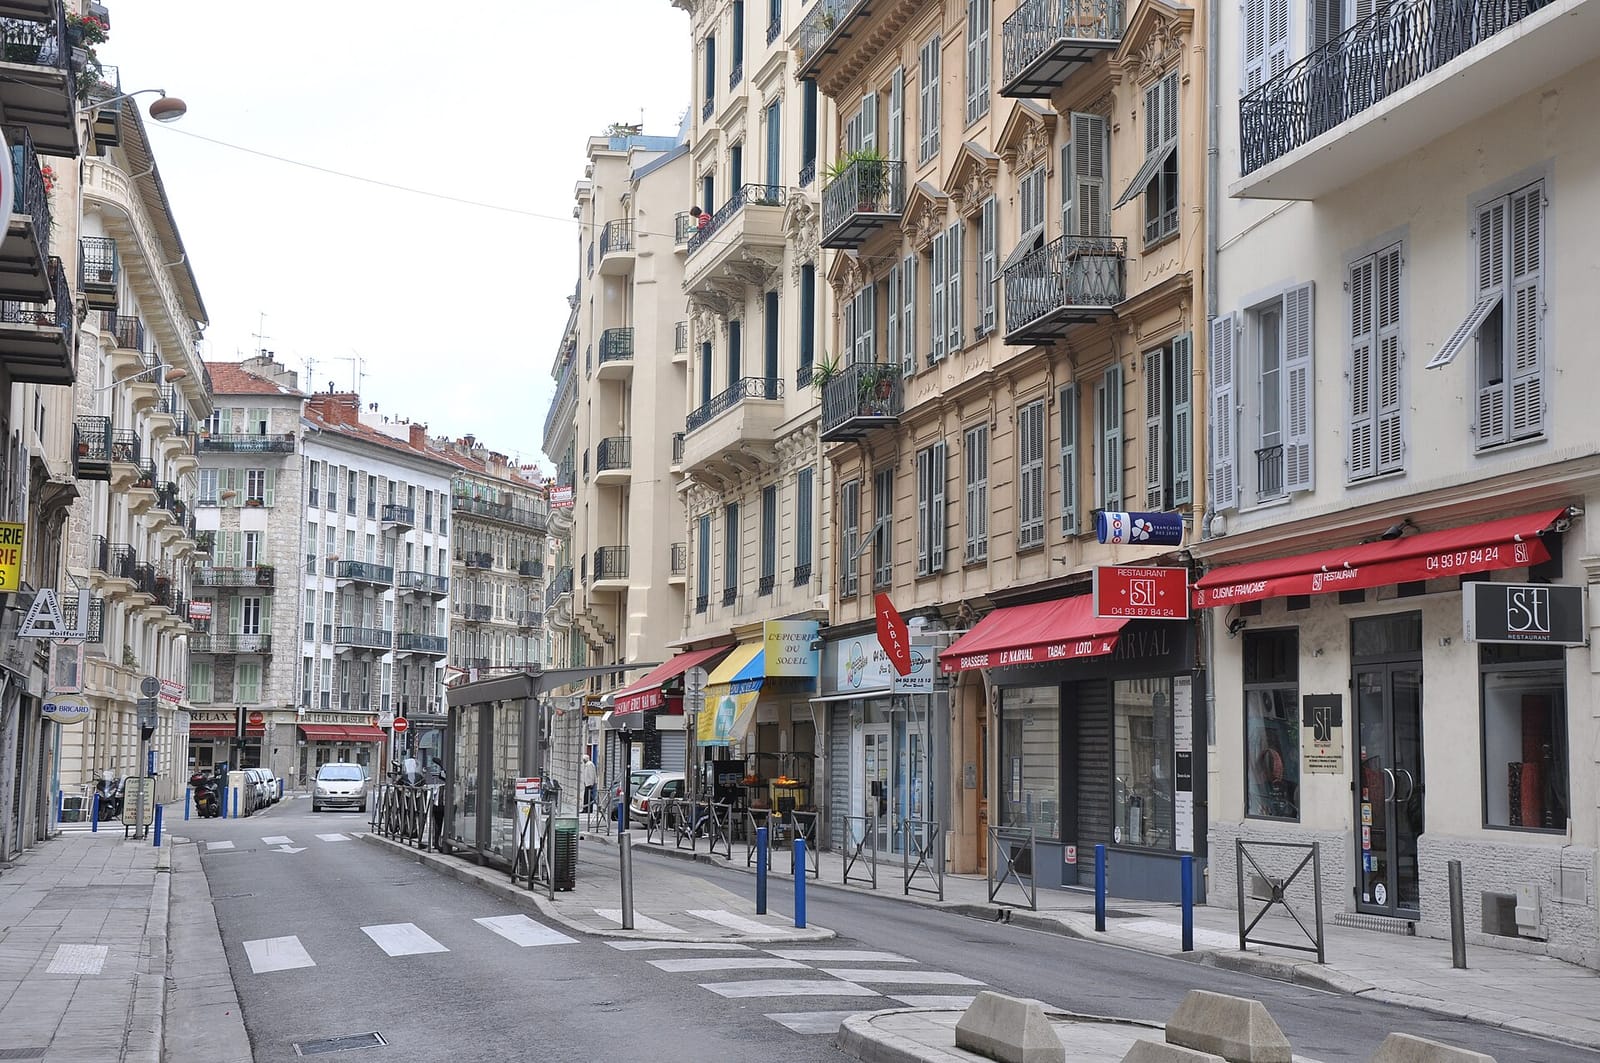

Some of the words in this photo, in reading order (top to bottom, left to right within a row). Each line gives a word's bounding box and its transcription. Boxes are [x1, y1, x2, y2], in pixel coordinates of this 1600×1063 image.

[1111, 513, 1122, 543] LOTO
[1427, 557, 1439, 570] 04
[1441, 555, 1453, 568] 93
[1455, 553, 1467, 566] 87
[1470, 550, 1482, 564] 84
[1485, 547, 1498, 561] 24
[1118, 569, 1167, 577] RESTAURANT
[1323, 569, 1359, 581] RESTAURANT
[1213, 588, 1234, 599] CUISINE
[1508, 587, 1550, 632] St
[882, 610, 903, 658] TABAC
[776, 656, 808, 664] SOLEIL
[961, 655, 989, 668] BRASSERIE
[1000, 652, 1008, 663] LE
[1009, 648, 1034, 662] NARVAL
[1047, 645, 1066, 658] TABAC
[1075, 641, 1092, 654] LOTO
[58, 705, 89, 713] BRICARD
[191, 712, 228, 721] RELAX
